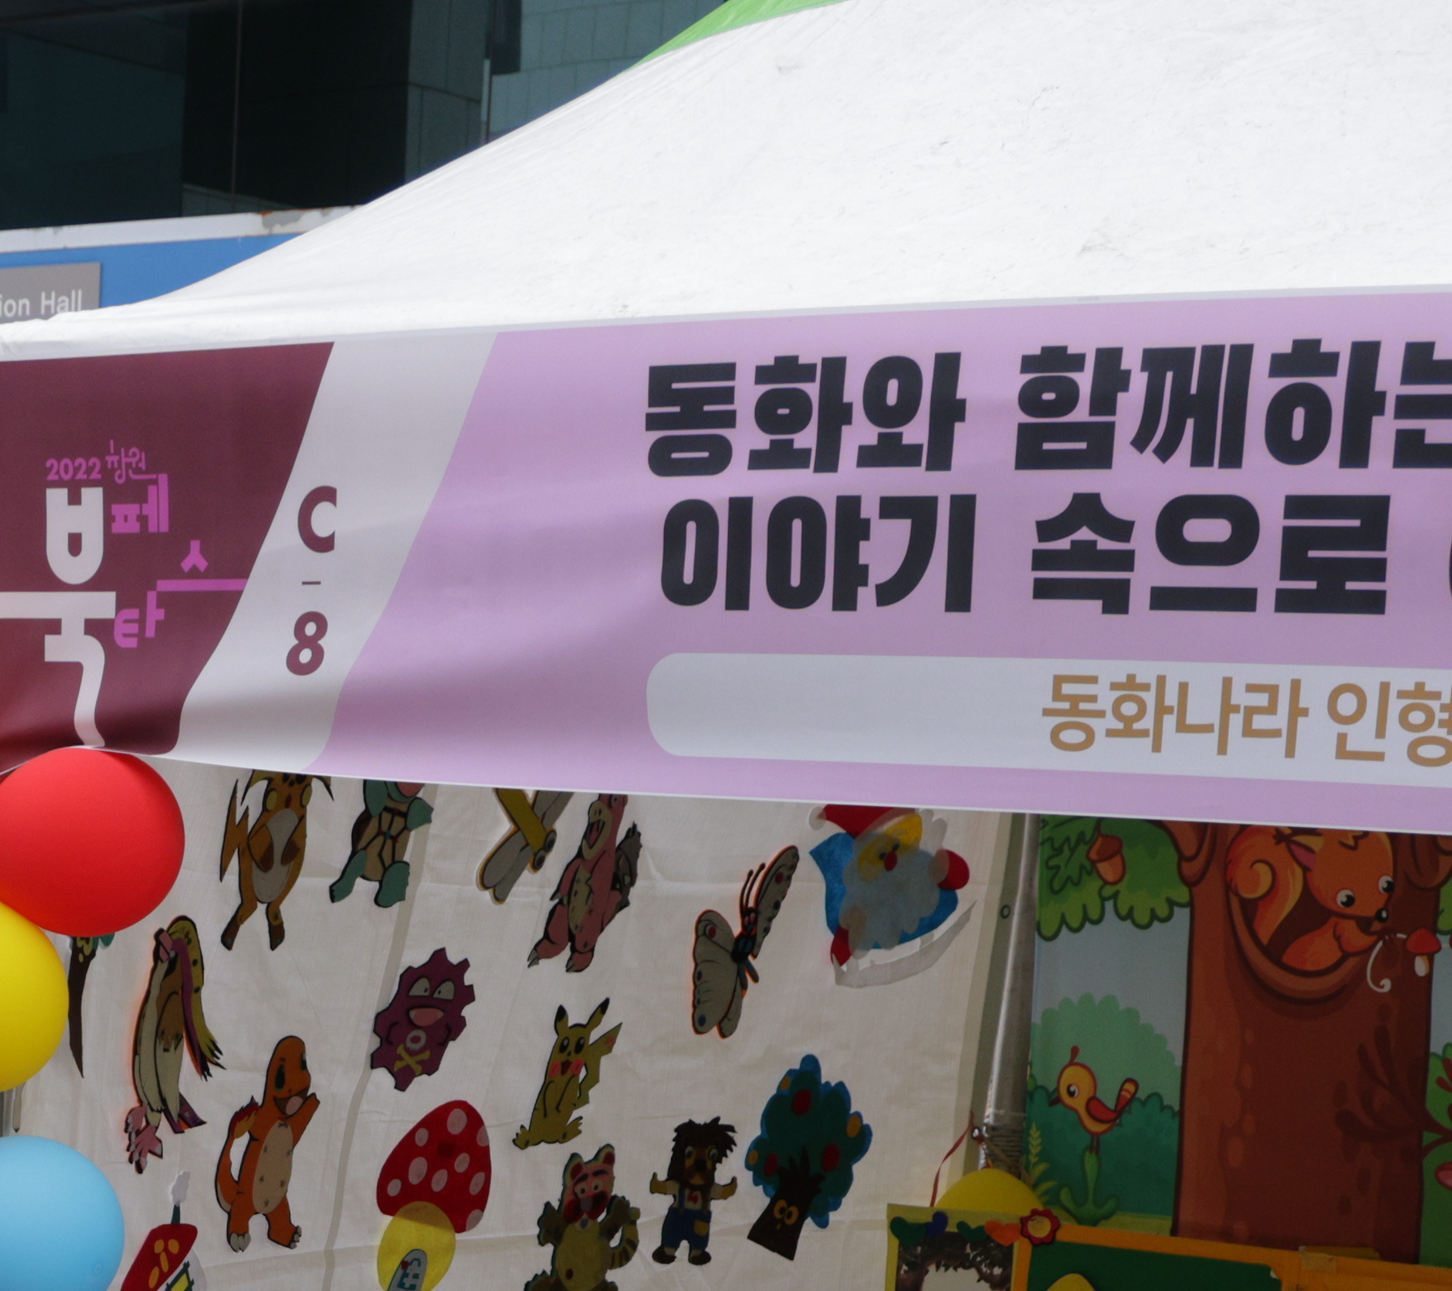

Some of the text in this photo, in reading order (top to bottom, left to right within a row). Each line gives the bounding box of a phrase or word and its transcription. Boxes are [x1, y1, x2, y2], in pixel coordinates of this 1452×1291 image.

[39, 289, 83, 316] Hall
[644, 351, 968, 478] 동화와
[45, 458, 102, 481] 2022
[659, 492, 977, 614] 이야기
[1031, 491, 1392, 616] 속으로
[1040, 672, 1310, 760] 동화나라
